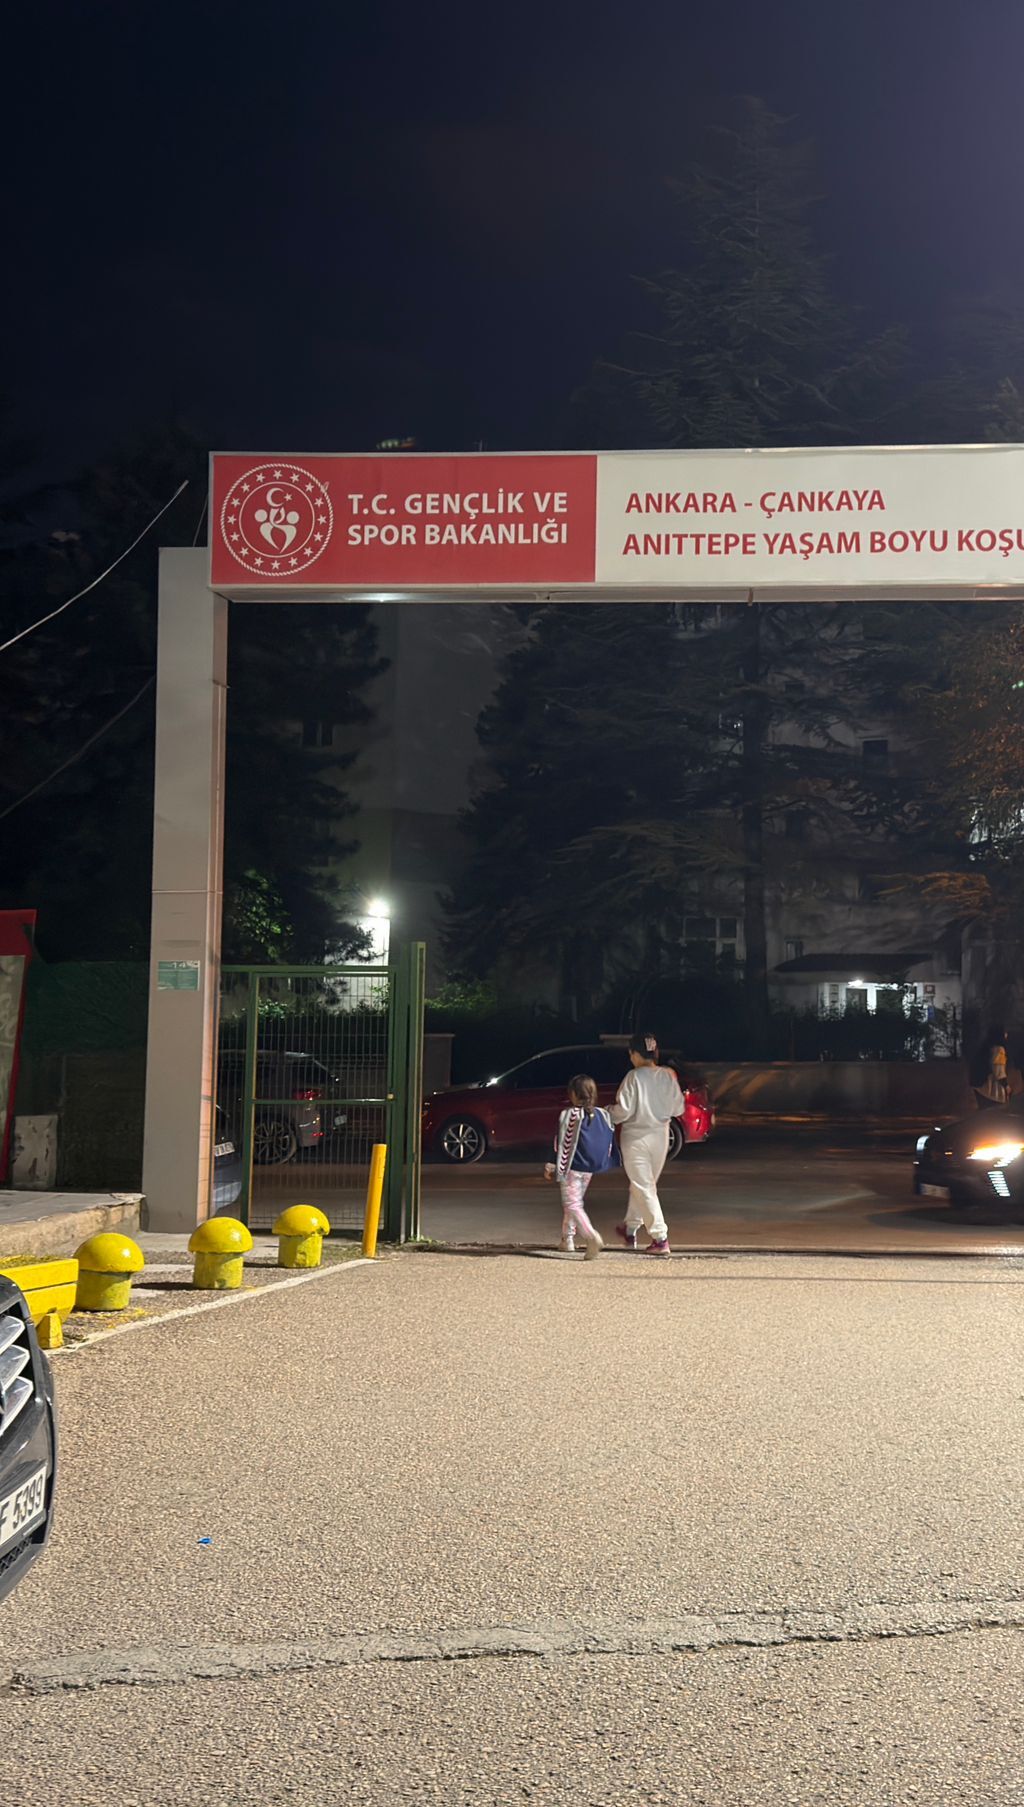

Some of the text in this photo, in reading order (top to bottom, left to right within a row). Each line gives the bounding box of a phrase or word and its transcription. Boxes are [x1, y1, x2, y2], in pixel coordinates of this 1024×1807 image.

[348, 488, 568, 520] T.C. GENÇLİK VE
[625, 492, 737, 513] ANKARA
[759, 489, 886, 519] ÇANKAYA
[347, 518, 568, 546] SPOR BAKANLIĞI
[622, 532, 757, 556] ANITTEPE
[762, 531, 861, 560] YAŞAM
[869, 530, 949, 554] BOYU
[12, 1475, 43, 1529] 5399
